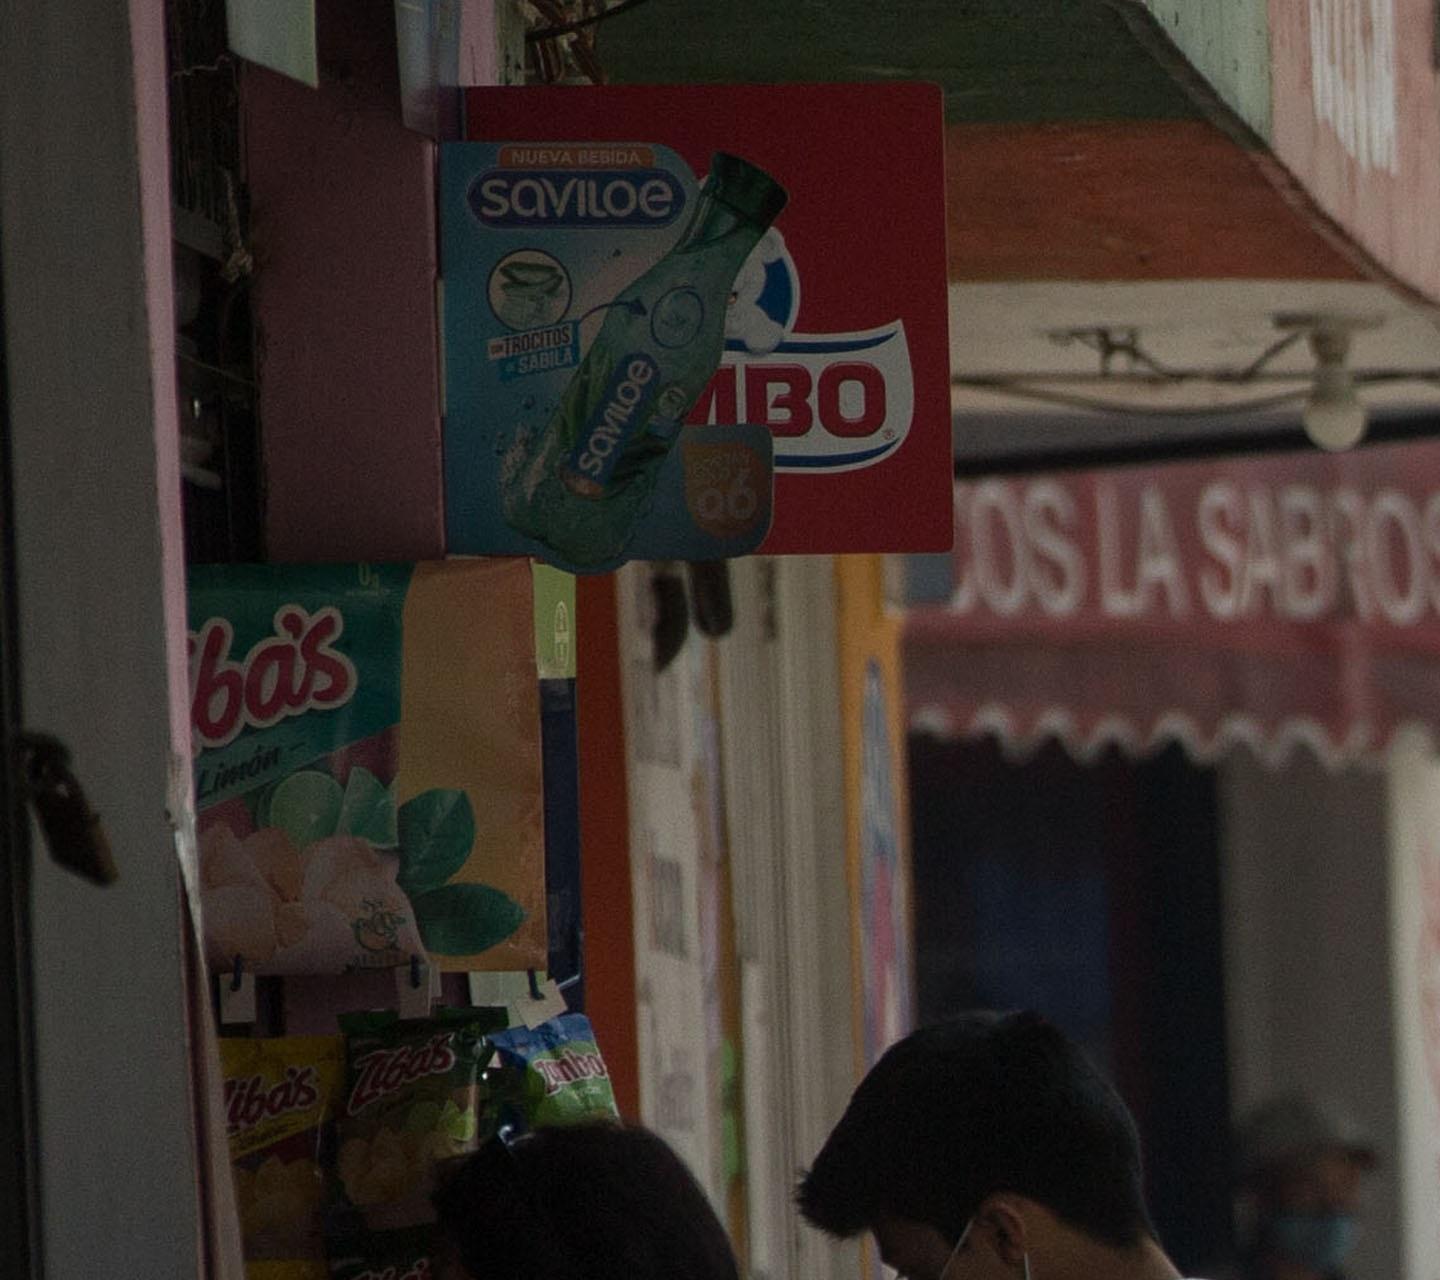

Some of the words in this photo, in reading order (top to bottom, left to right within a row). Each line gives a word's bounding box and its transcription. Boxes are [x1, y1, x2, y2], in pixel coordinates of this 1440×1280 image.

[511, 149, 574, 166] NUEVA
[577, 149, 642, 166] BEBIDA
[504, 325, 571, 355] TROCITOS
[517, 347, 573, 373] SABILA
[1095, 480, 1189, 618] LA
